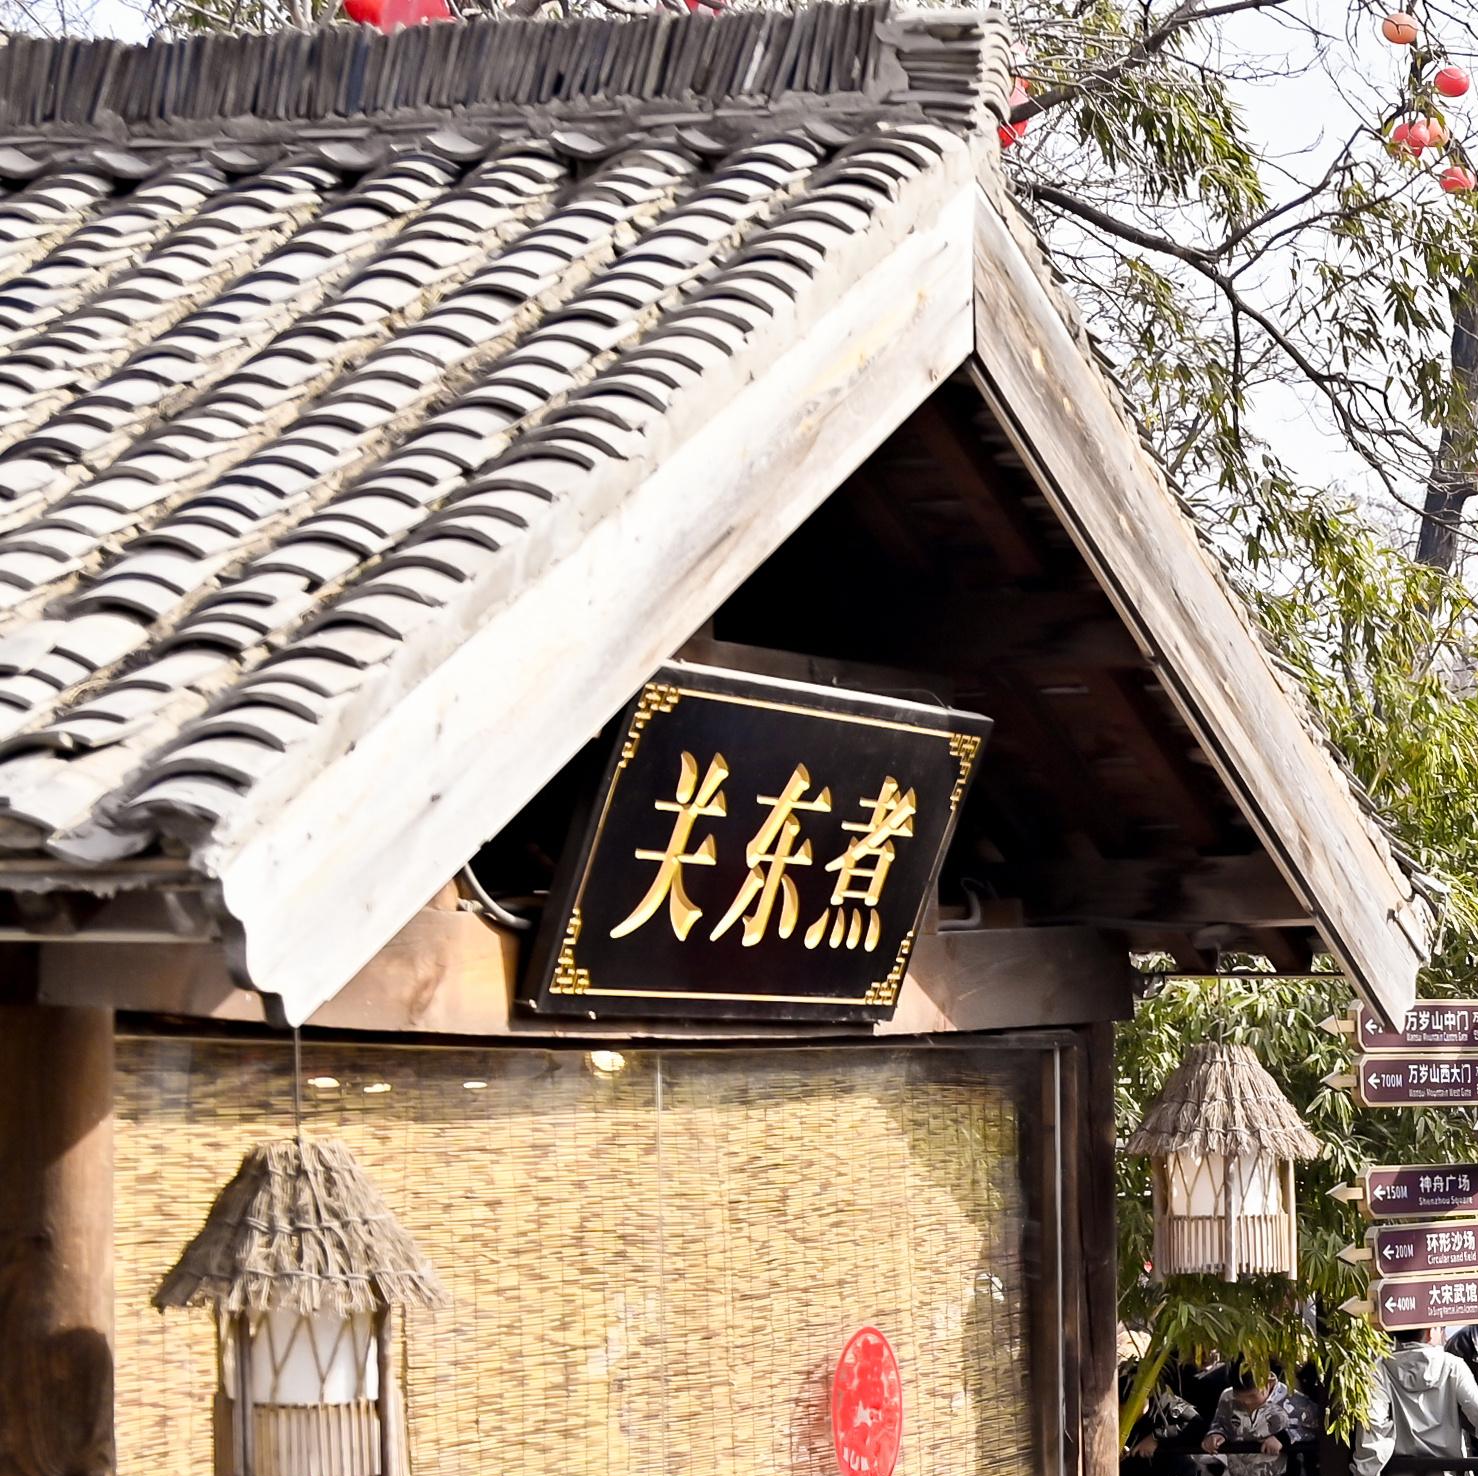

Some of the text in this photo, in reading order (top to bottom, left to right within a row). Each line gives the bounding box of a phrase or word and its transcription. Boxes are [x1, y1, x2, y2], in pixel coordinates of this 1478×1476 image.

[609, 750, 917, 953] 关东煮
[1405, 1010, 1469, 1031] 万岁山中门
[1381, 1074, 1403, 1088] 700M
[1408, 1064, 1472, 1084] 万岁山西大门
[1386, 1185, 1408, 1199] 150M
[1419, 1174, 1471, 1193] 神舟广场
[1395, 1244, 1414, 1259] 200M
[1426, 1230, 1476, 1254] 环形沙场
[1427, 1253, 1450, 1265] Circular
[1450, 1252, 1463, 1263] sand
[1428, 1282, 1478, 1306] 大宋武馆
[1397, 1296, 1416, 1312] 400M
